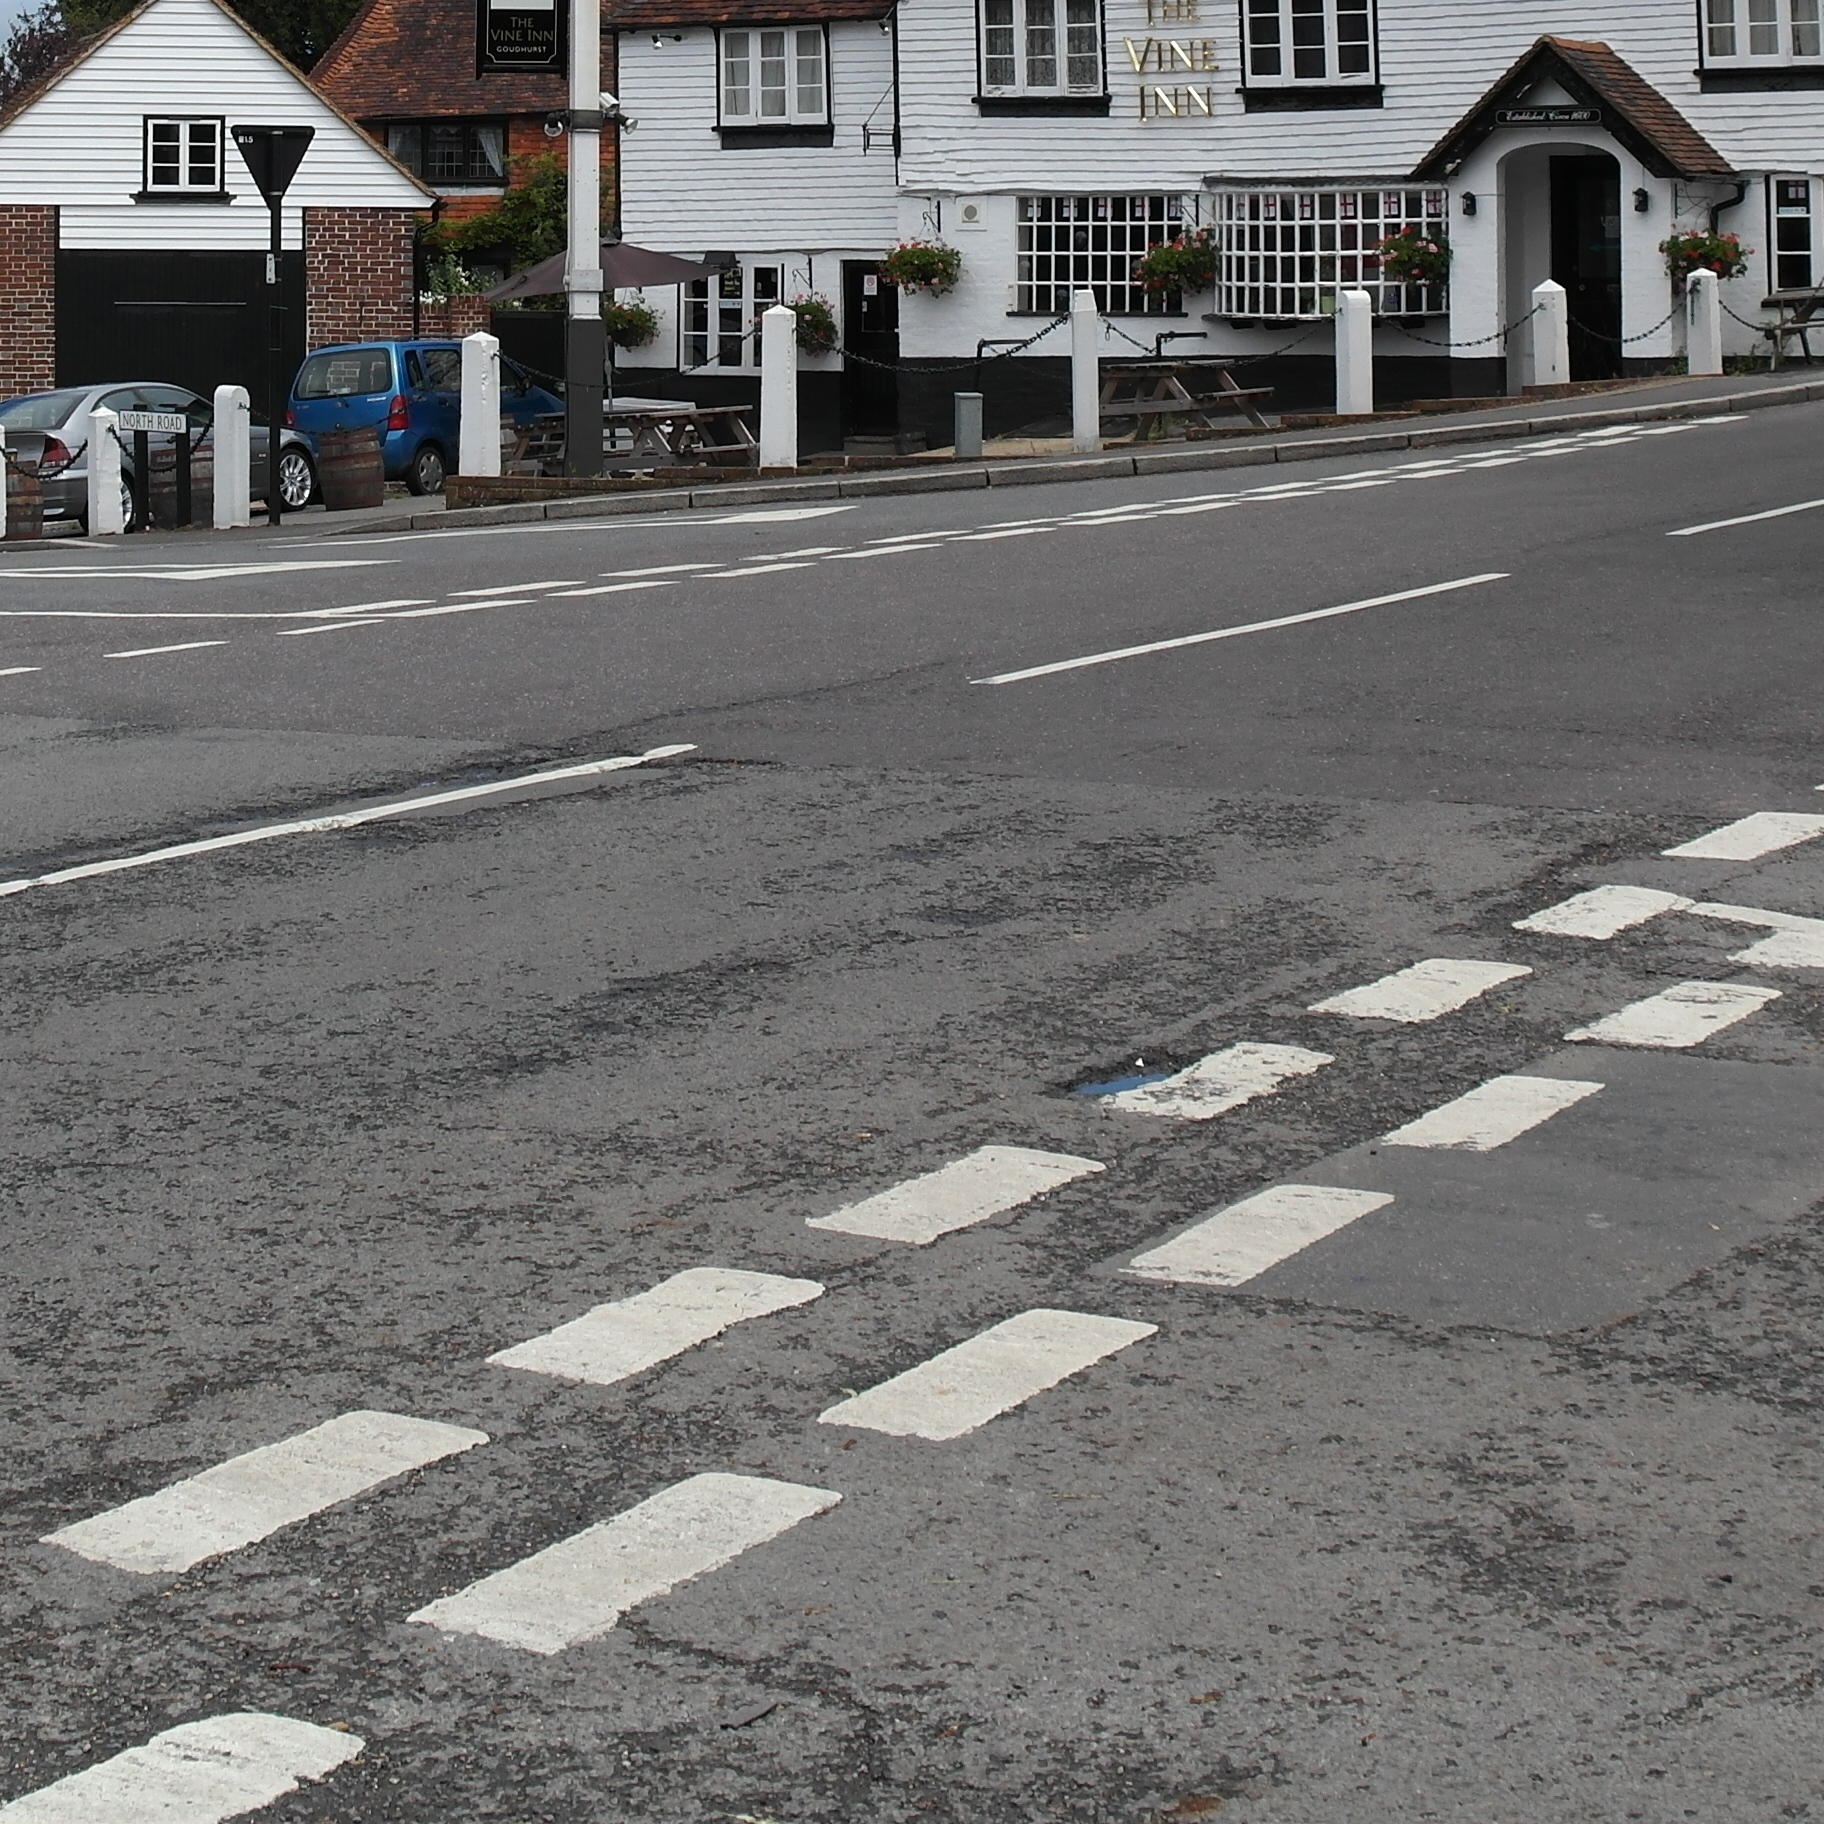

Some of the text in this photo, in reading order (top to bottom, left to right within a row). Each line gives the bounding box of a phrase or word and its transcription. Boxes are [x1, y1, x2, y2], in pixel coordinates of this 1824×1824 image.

[510, 16, 534, 28] THE
[490, 29, 554, 42] VINE INN
[496, 45, 547, 53] GOUDHURST
[1123, 37, 1220, 74] VINE
[1139, 85, 1212, 123] INN
[122, 413, 182, 431] NORTH ROAD
